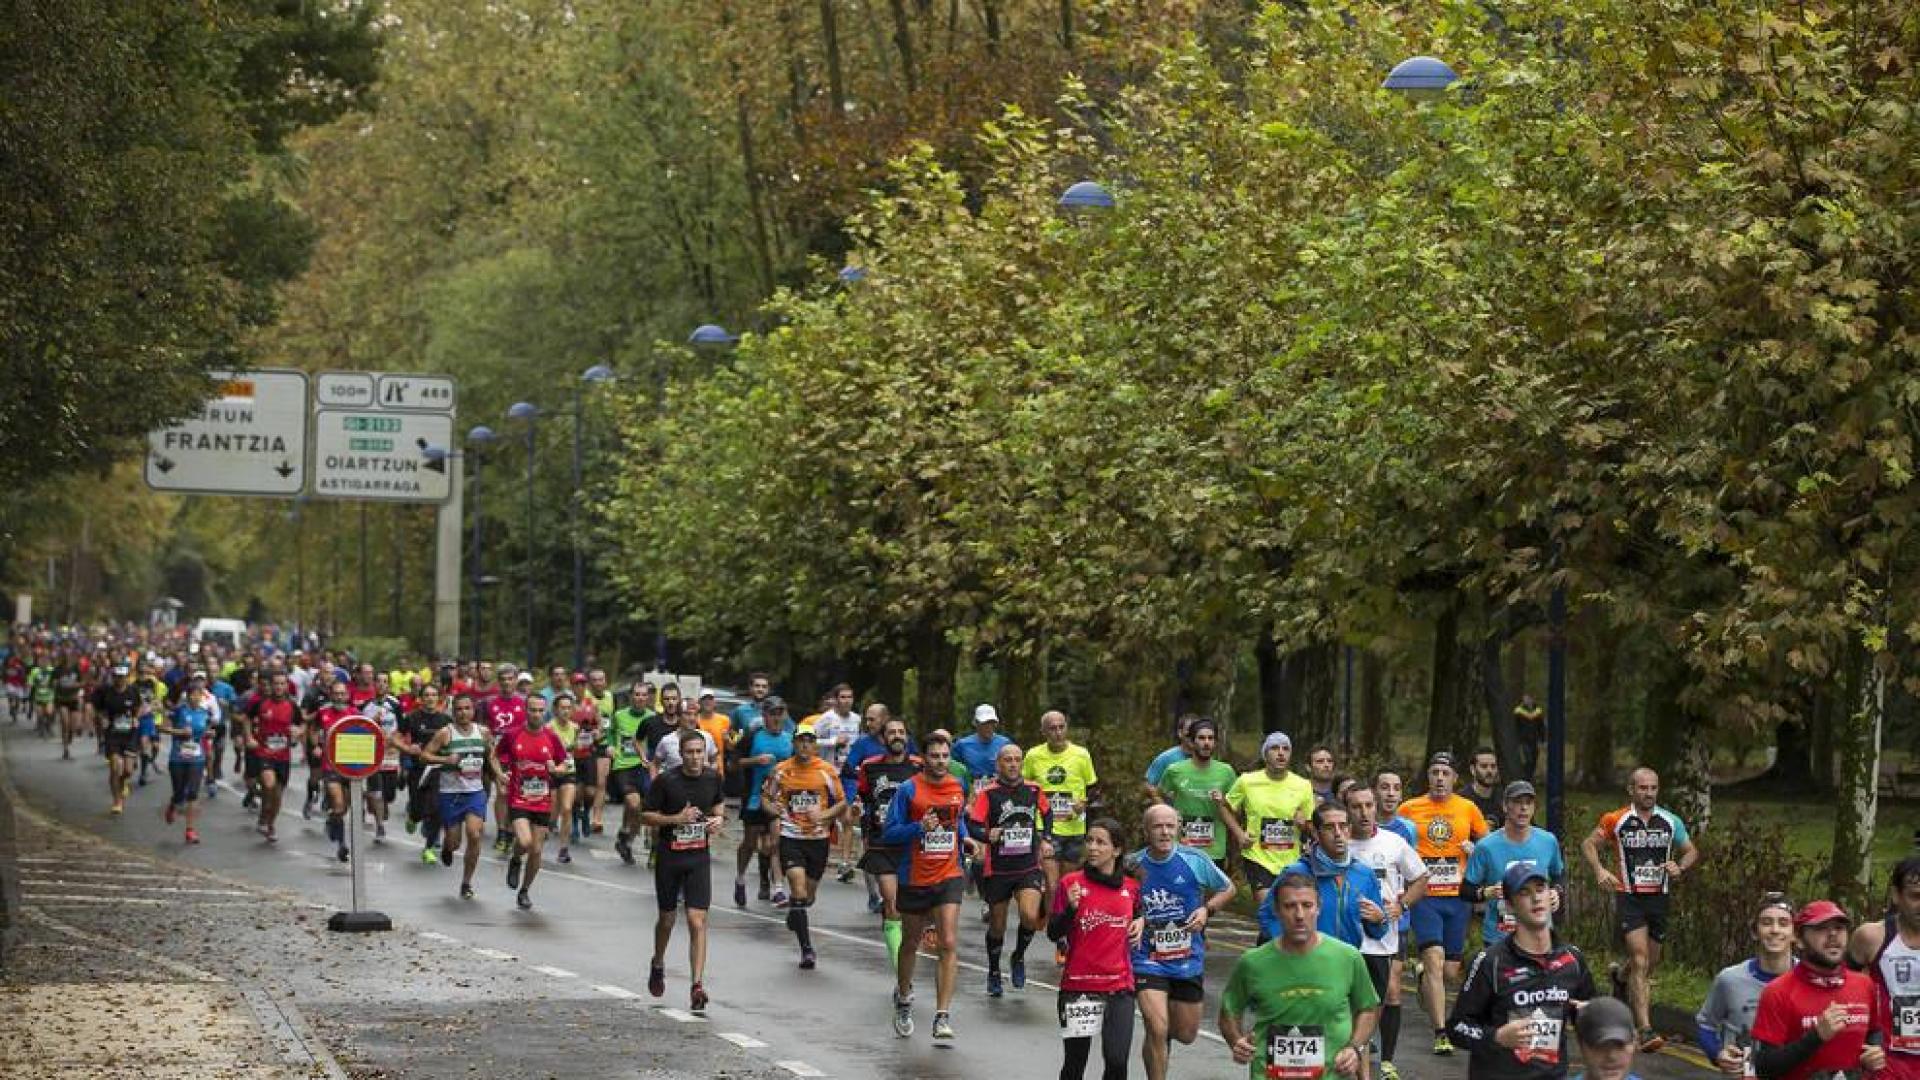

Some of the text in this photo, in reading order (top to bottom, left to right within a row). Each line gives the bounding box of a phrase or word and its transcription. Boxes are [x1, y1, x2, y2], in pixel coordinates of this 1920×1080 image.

[164, 431, 286, 453] FRANTZIA
[325, 456, 418, 472] OIARTZUN
[319, 479, 420, 492] ASTIGARRAGA
[1276, 1038, 1318, 1056] 5174
